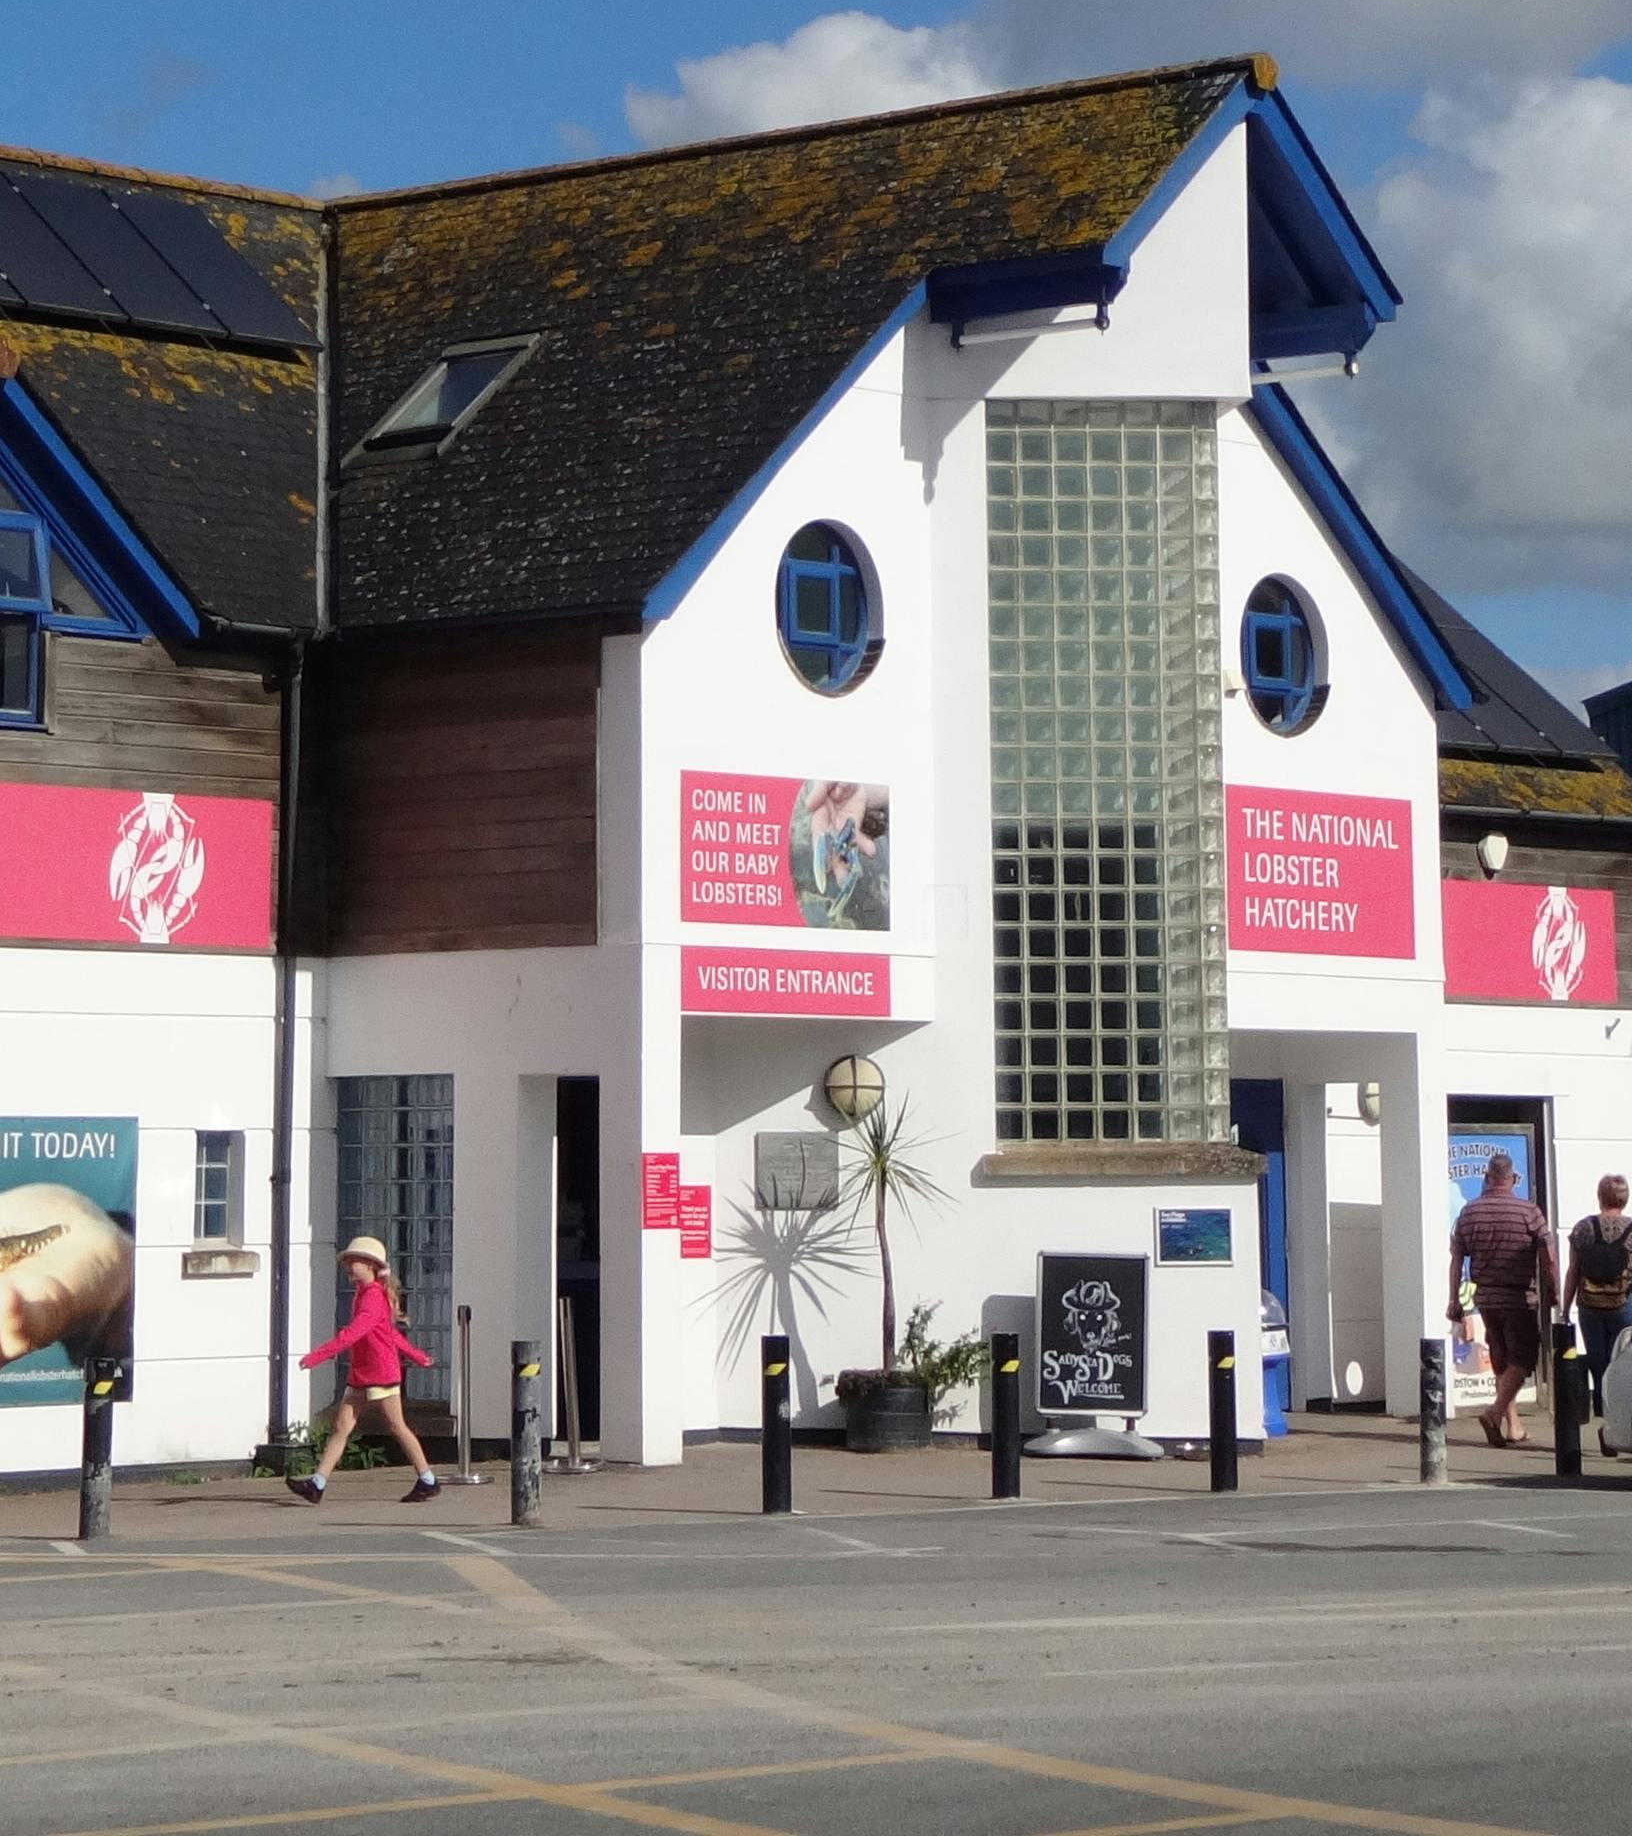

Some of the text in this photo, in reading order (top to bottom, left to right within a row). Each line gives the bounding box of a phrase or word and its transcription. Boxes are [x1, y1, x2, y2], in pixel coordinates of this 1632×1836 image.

[692, 789, 766, 814] COME IN
[692, 820, 781, 845] AND MEET
[1242, 808, 1399, 849] THE NATIONAL
[692, 851, 779, 875] OUR BABY
[1245, 852, 1339, 888] LOBSTER
[692, 881, 782, 906] LOBSTERS!
[1245, 897, 1358, 932] HATCHERY
[698, 966, 874, 995] VISITOR ENTRANCE
[31, 1132, 115, 1159] TODAY!
[1049, 1380, 1121, 1404] WELCOME
